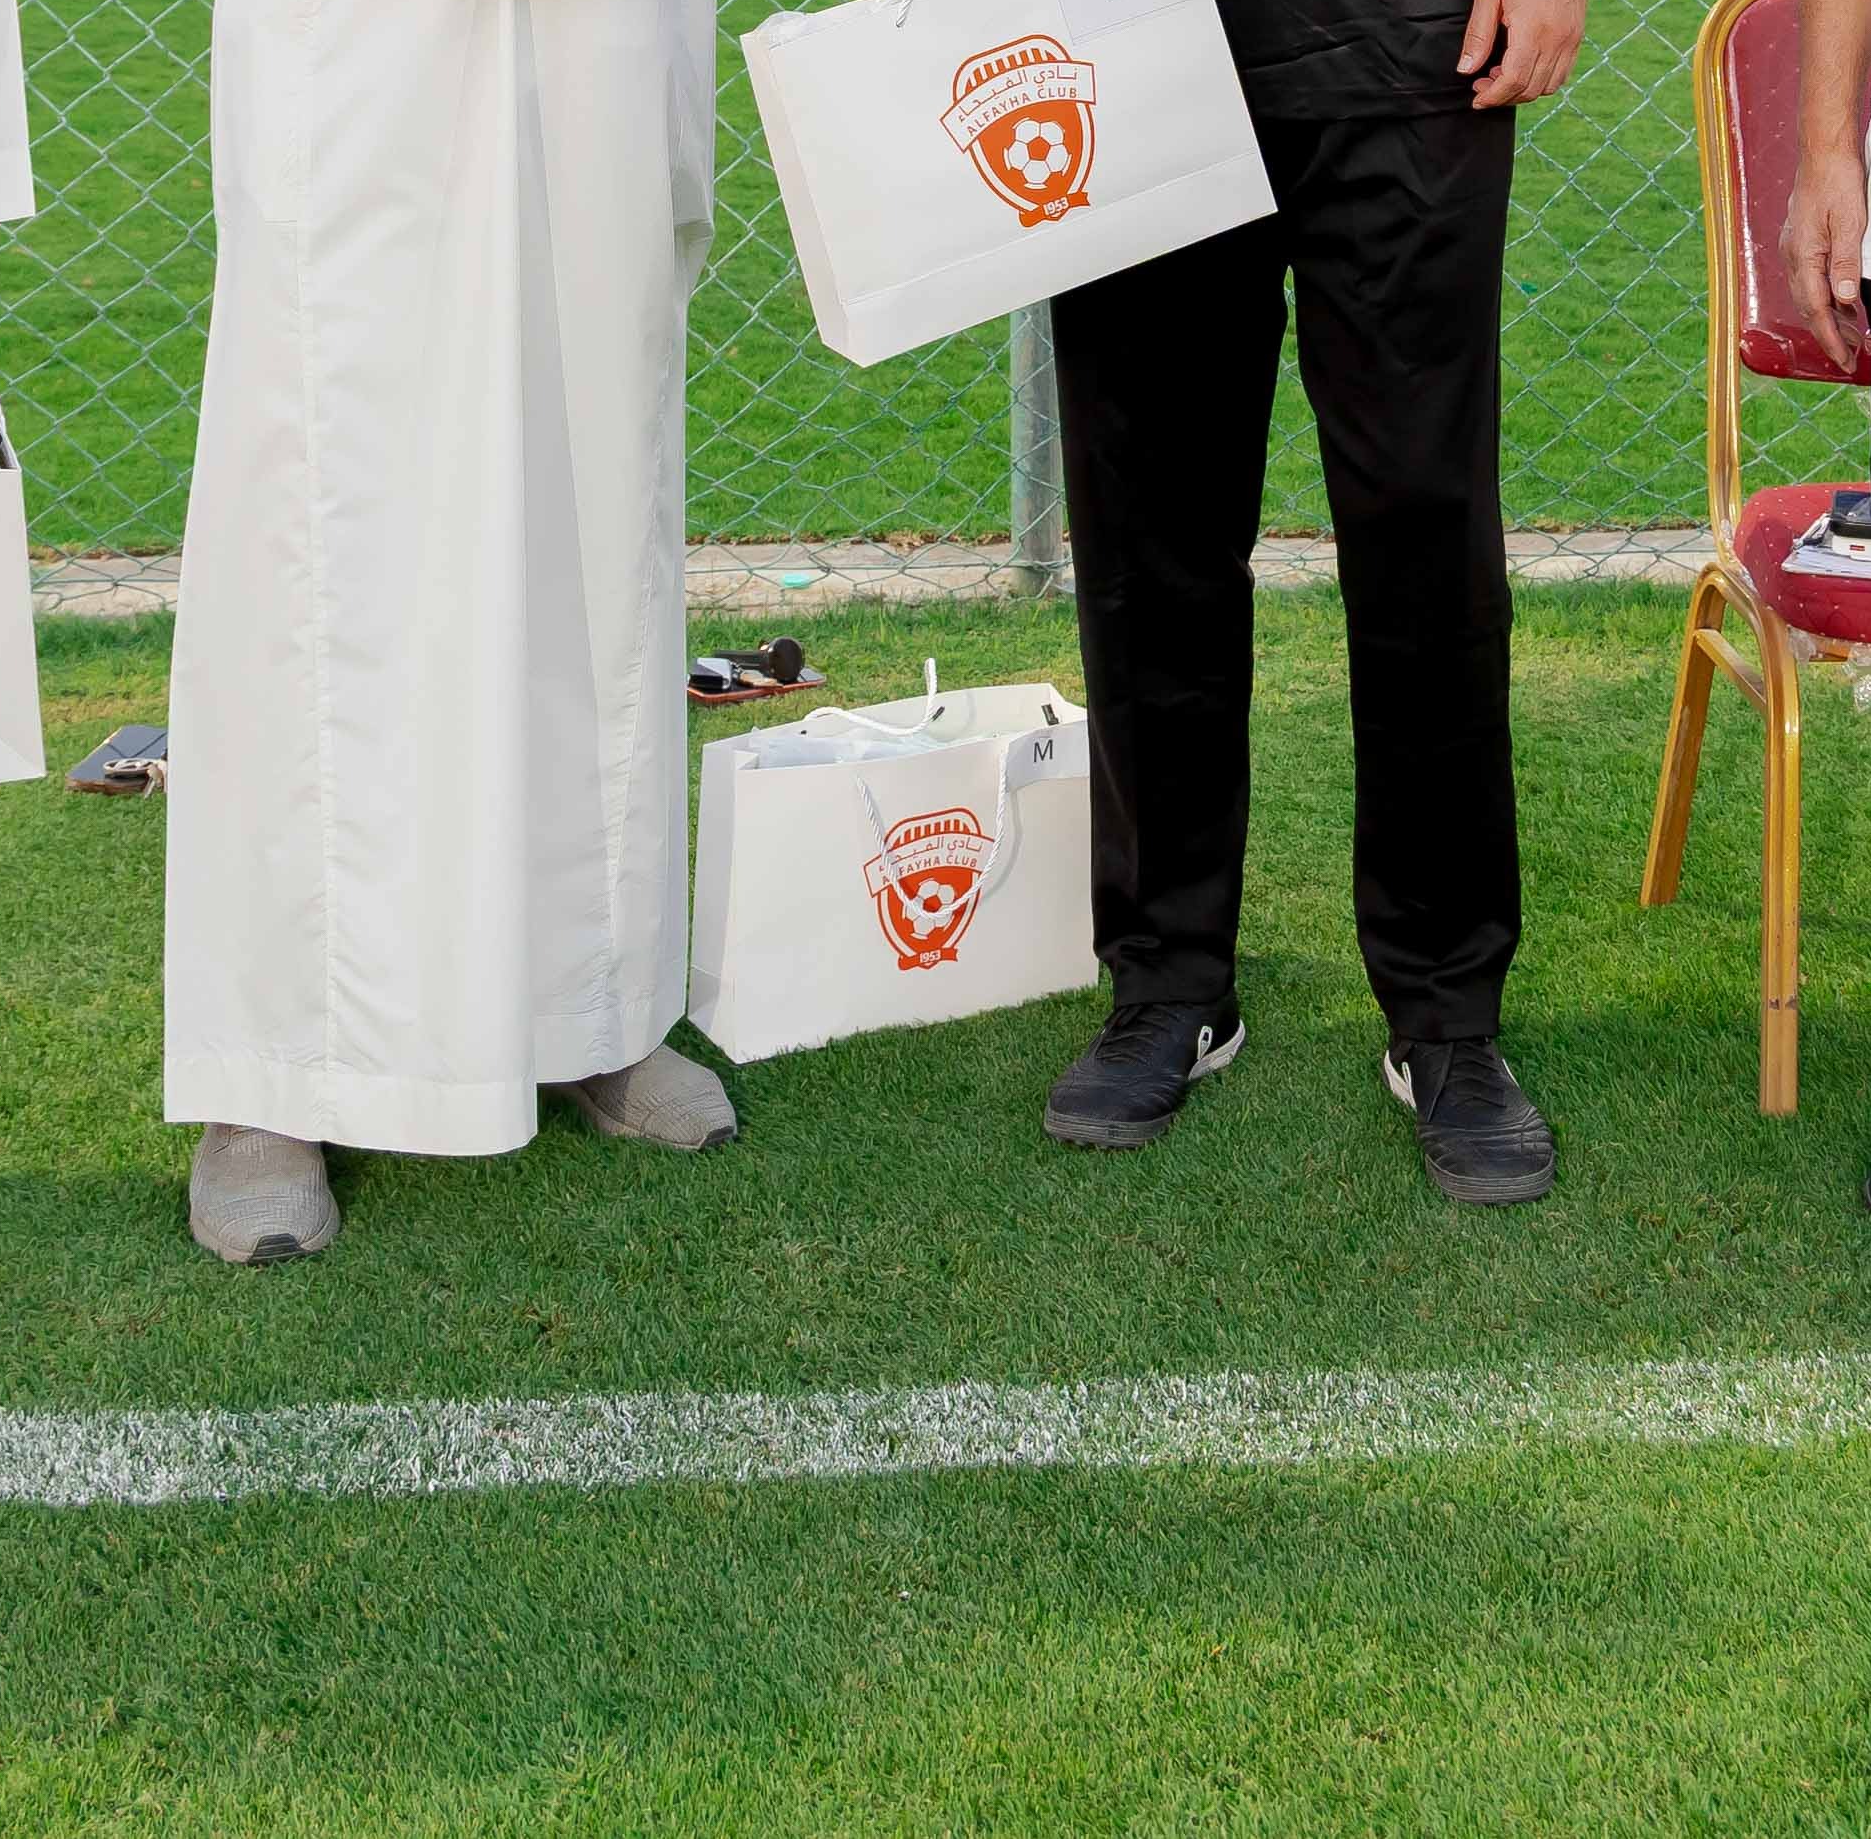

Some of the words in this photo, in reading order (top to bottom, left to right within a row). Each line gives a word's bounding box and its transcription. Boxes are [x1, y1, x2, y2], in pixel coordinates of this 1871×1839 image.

[1033, 65, 1078, 89] نادي
[959, 69, 1027, 122] الفيحاء
[966, 93, 1031, 136] ALFAYHA
[1037, 87, 1077, 99] CLUB
[1043, 196, 1069, 215] 1953
[1033, 739, 1053, 763] M
[947, 837, 982, 855] نادي
[882, 856, 940, 885] AFAYHA
[919, 950, 941, 963] 1953
[946, 855, 978, 868] CLUB
